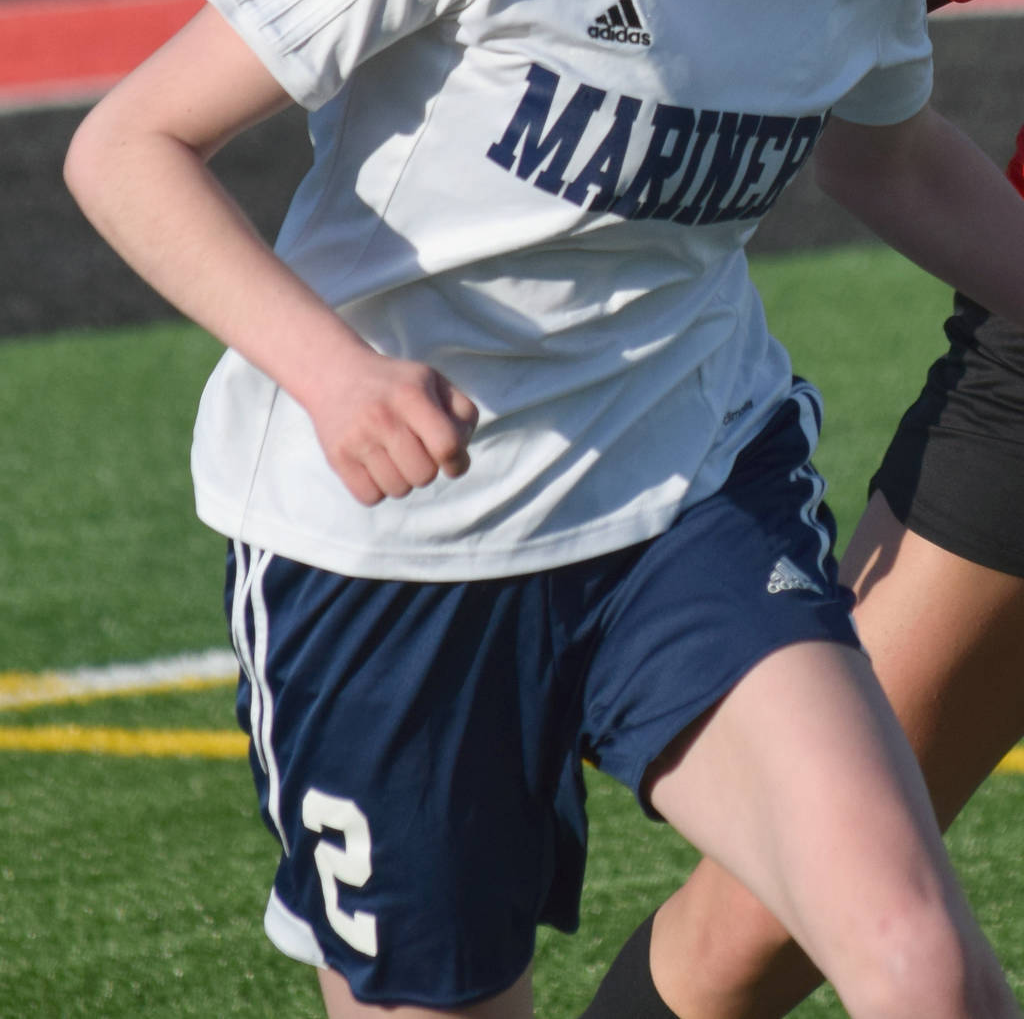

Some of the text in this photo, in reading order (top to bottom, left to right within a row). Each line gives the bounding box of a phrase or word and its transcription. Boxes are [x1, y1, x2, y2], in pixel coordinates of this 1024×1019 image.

[587, 25, 651, 46] adidas
[486, 62, 832, 226] MARINER
[302, 787, 378, 958] 2
